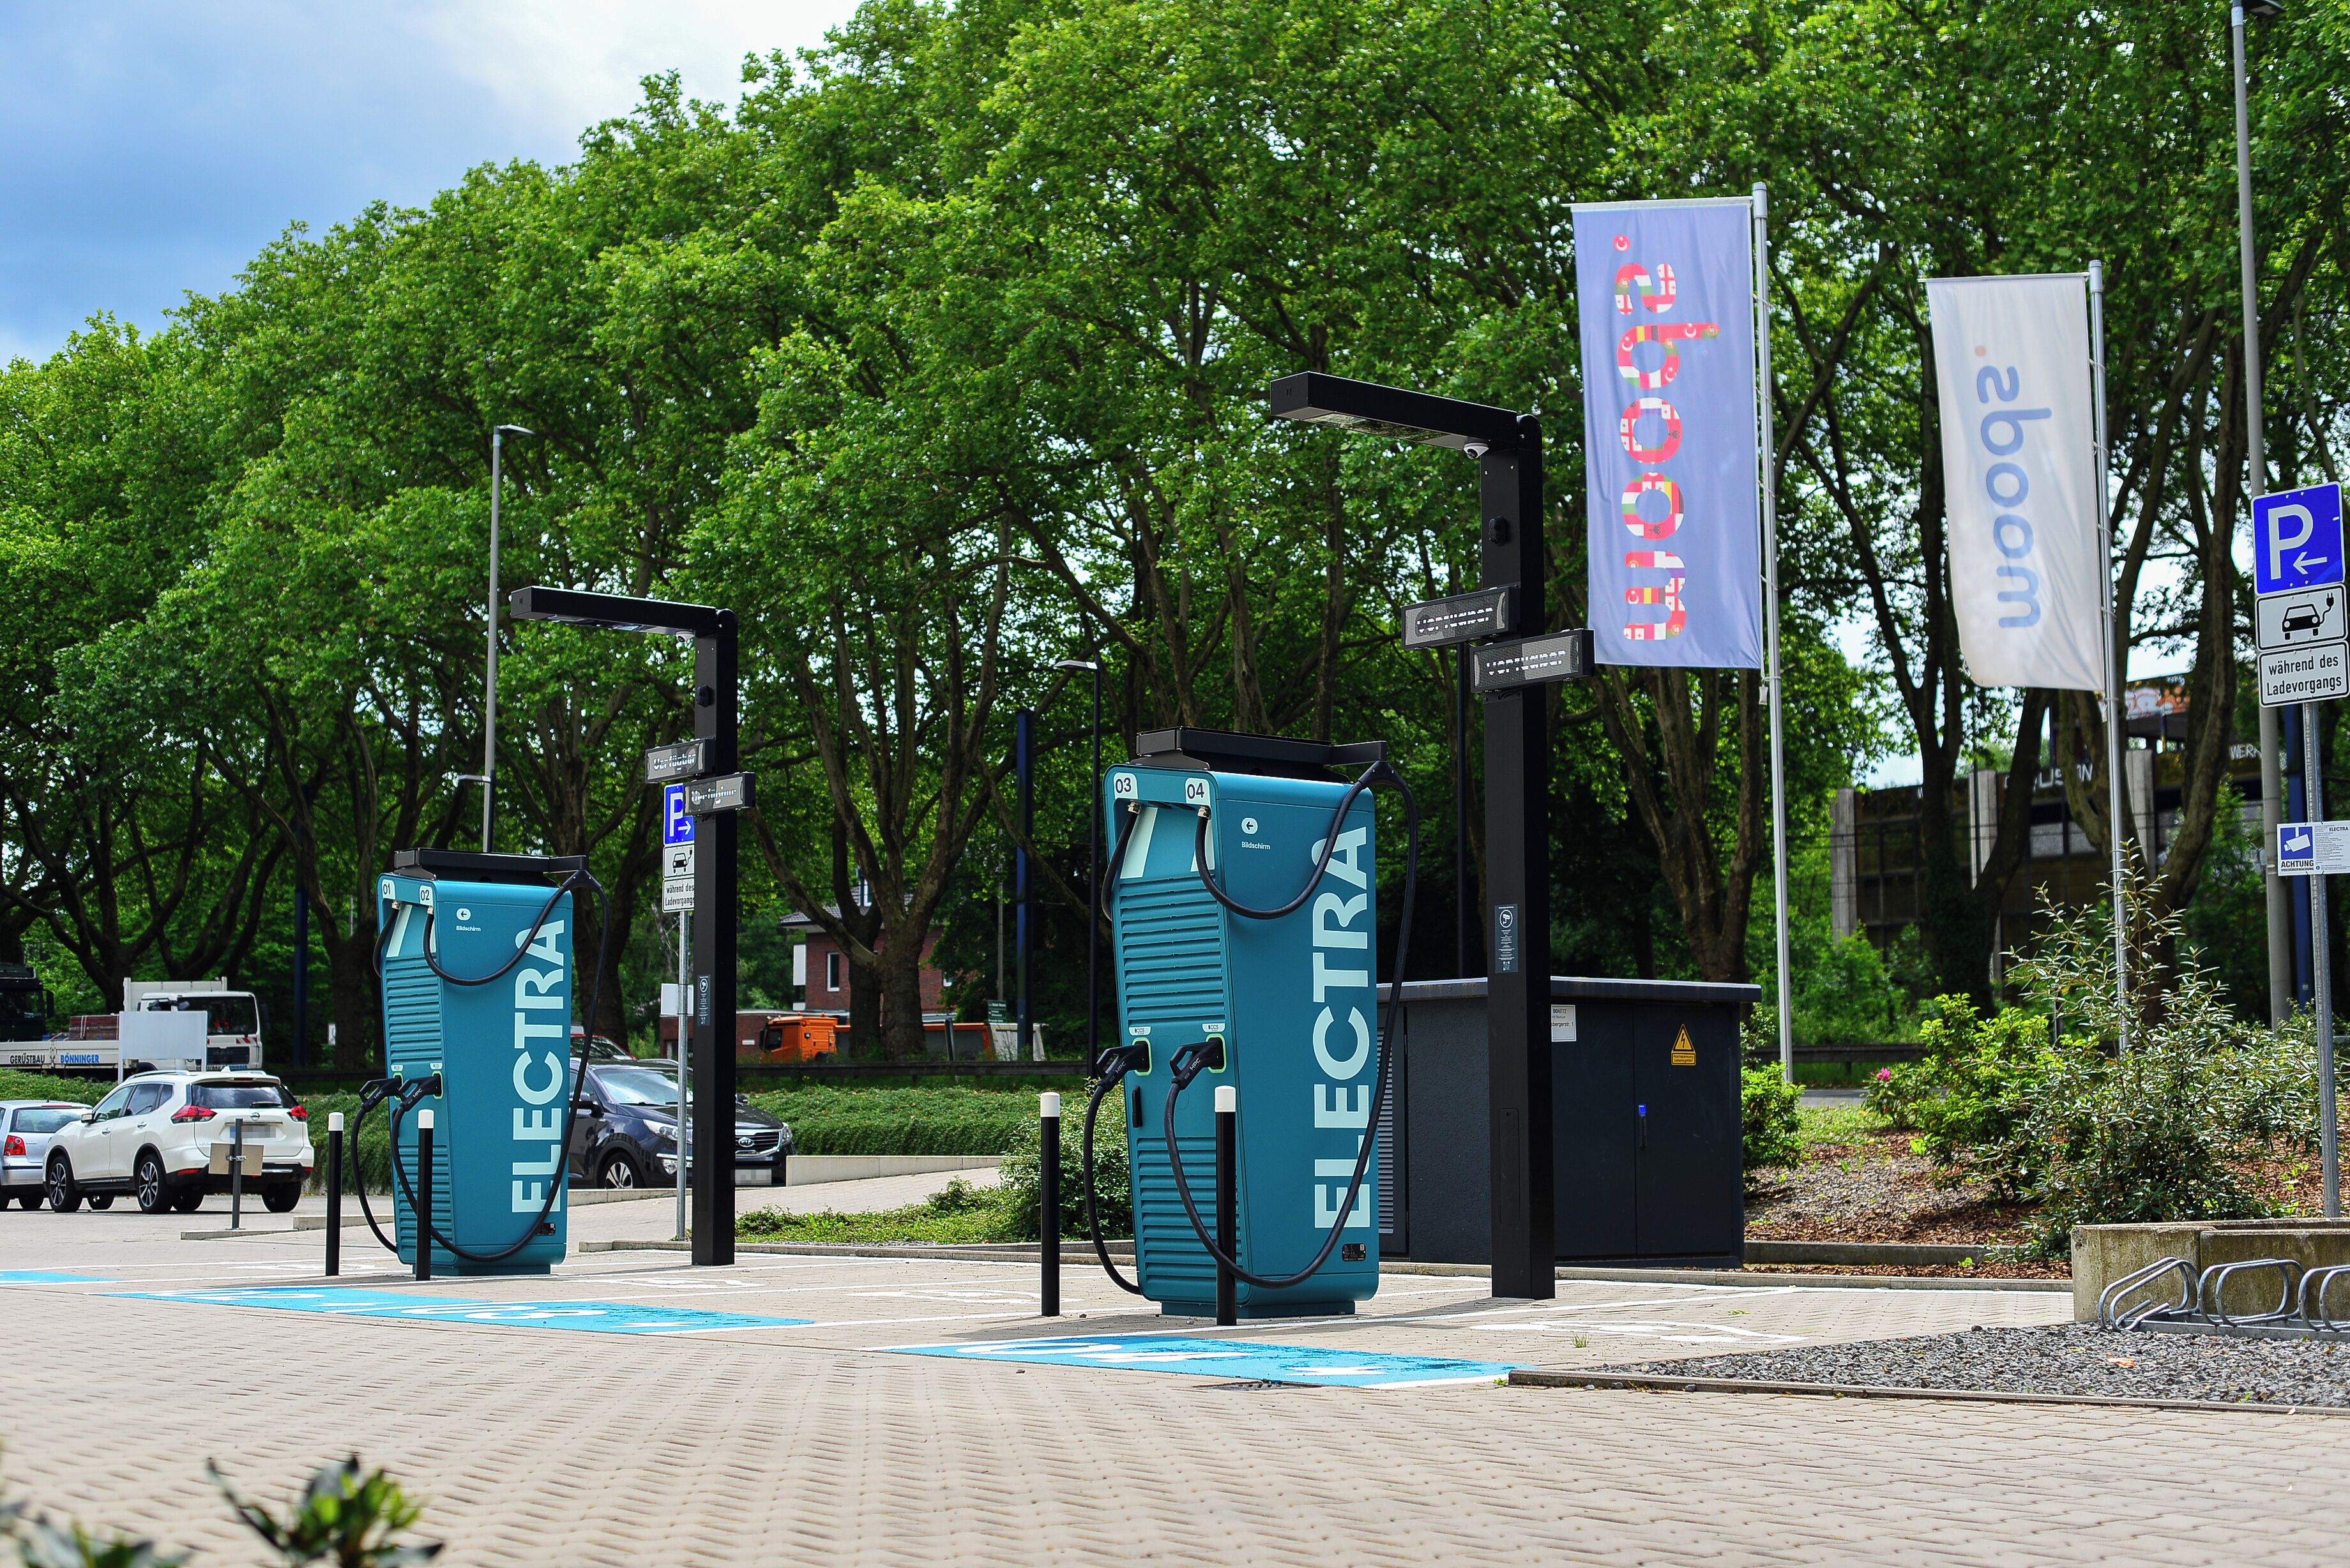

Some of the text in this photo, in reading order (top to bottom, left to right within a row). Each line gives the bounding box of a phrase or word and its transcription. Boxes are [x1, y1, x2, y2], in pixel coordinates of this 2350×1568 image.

[2268, 504, 2313, 580] P
[2268, 653, 2339, 675] während des
[2266, 675, 2342, 697] Ladevorgangs
[1115, 777, 1132, 794] 03
[1186, 783, 1205, 799] 04
[669, 792, 683, 837] P
[1241, 841, 1271, 850] Bildschirm
[383, 884, 391, 895] 01
[420, 889, 430, 901] 02
[666, 885, 684, 894] während
[1311, 826, 1370, 1229] ELECTRA
[10, 1053, 100, 1064] GERÜSTBAU BÖNNINGER
[512, 919, 565, 1213] ELECTRA
[1115, 1060, 1126, 1073] HPC
[1189, 1057, 1201, 1072] HPC
